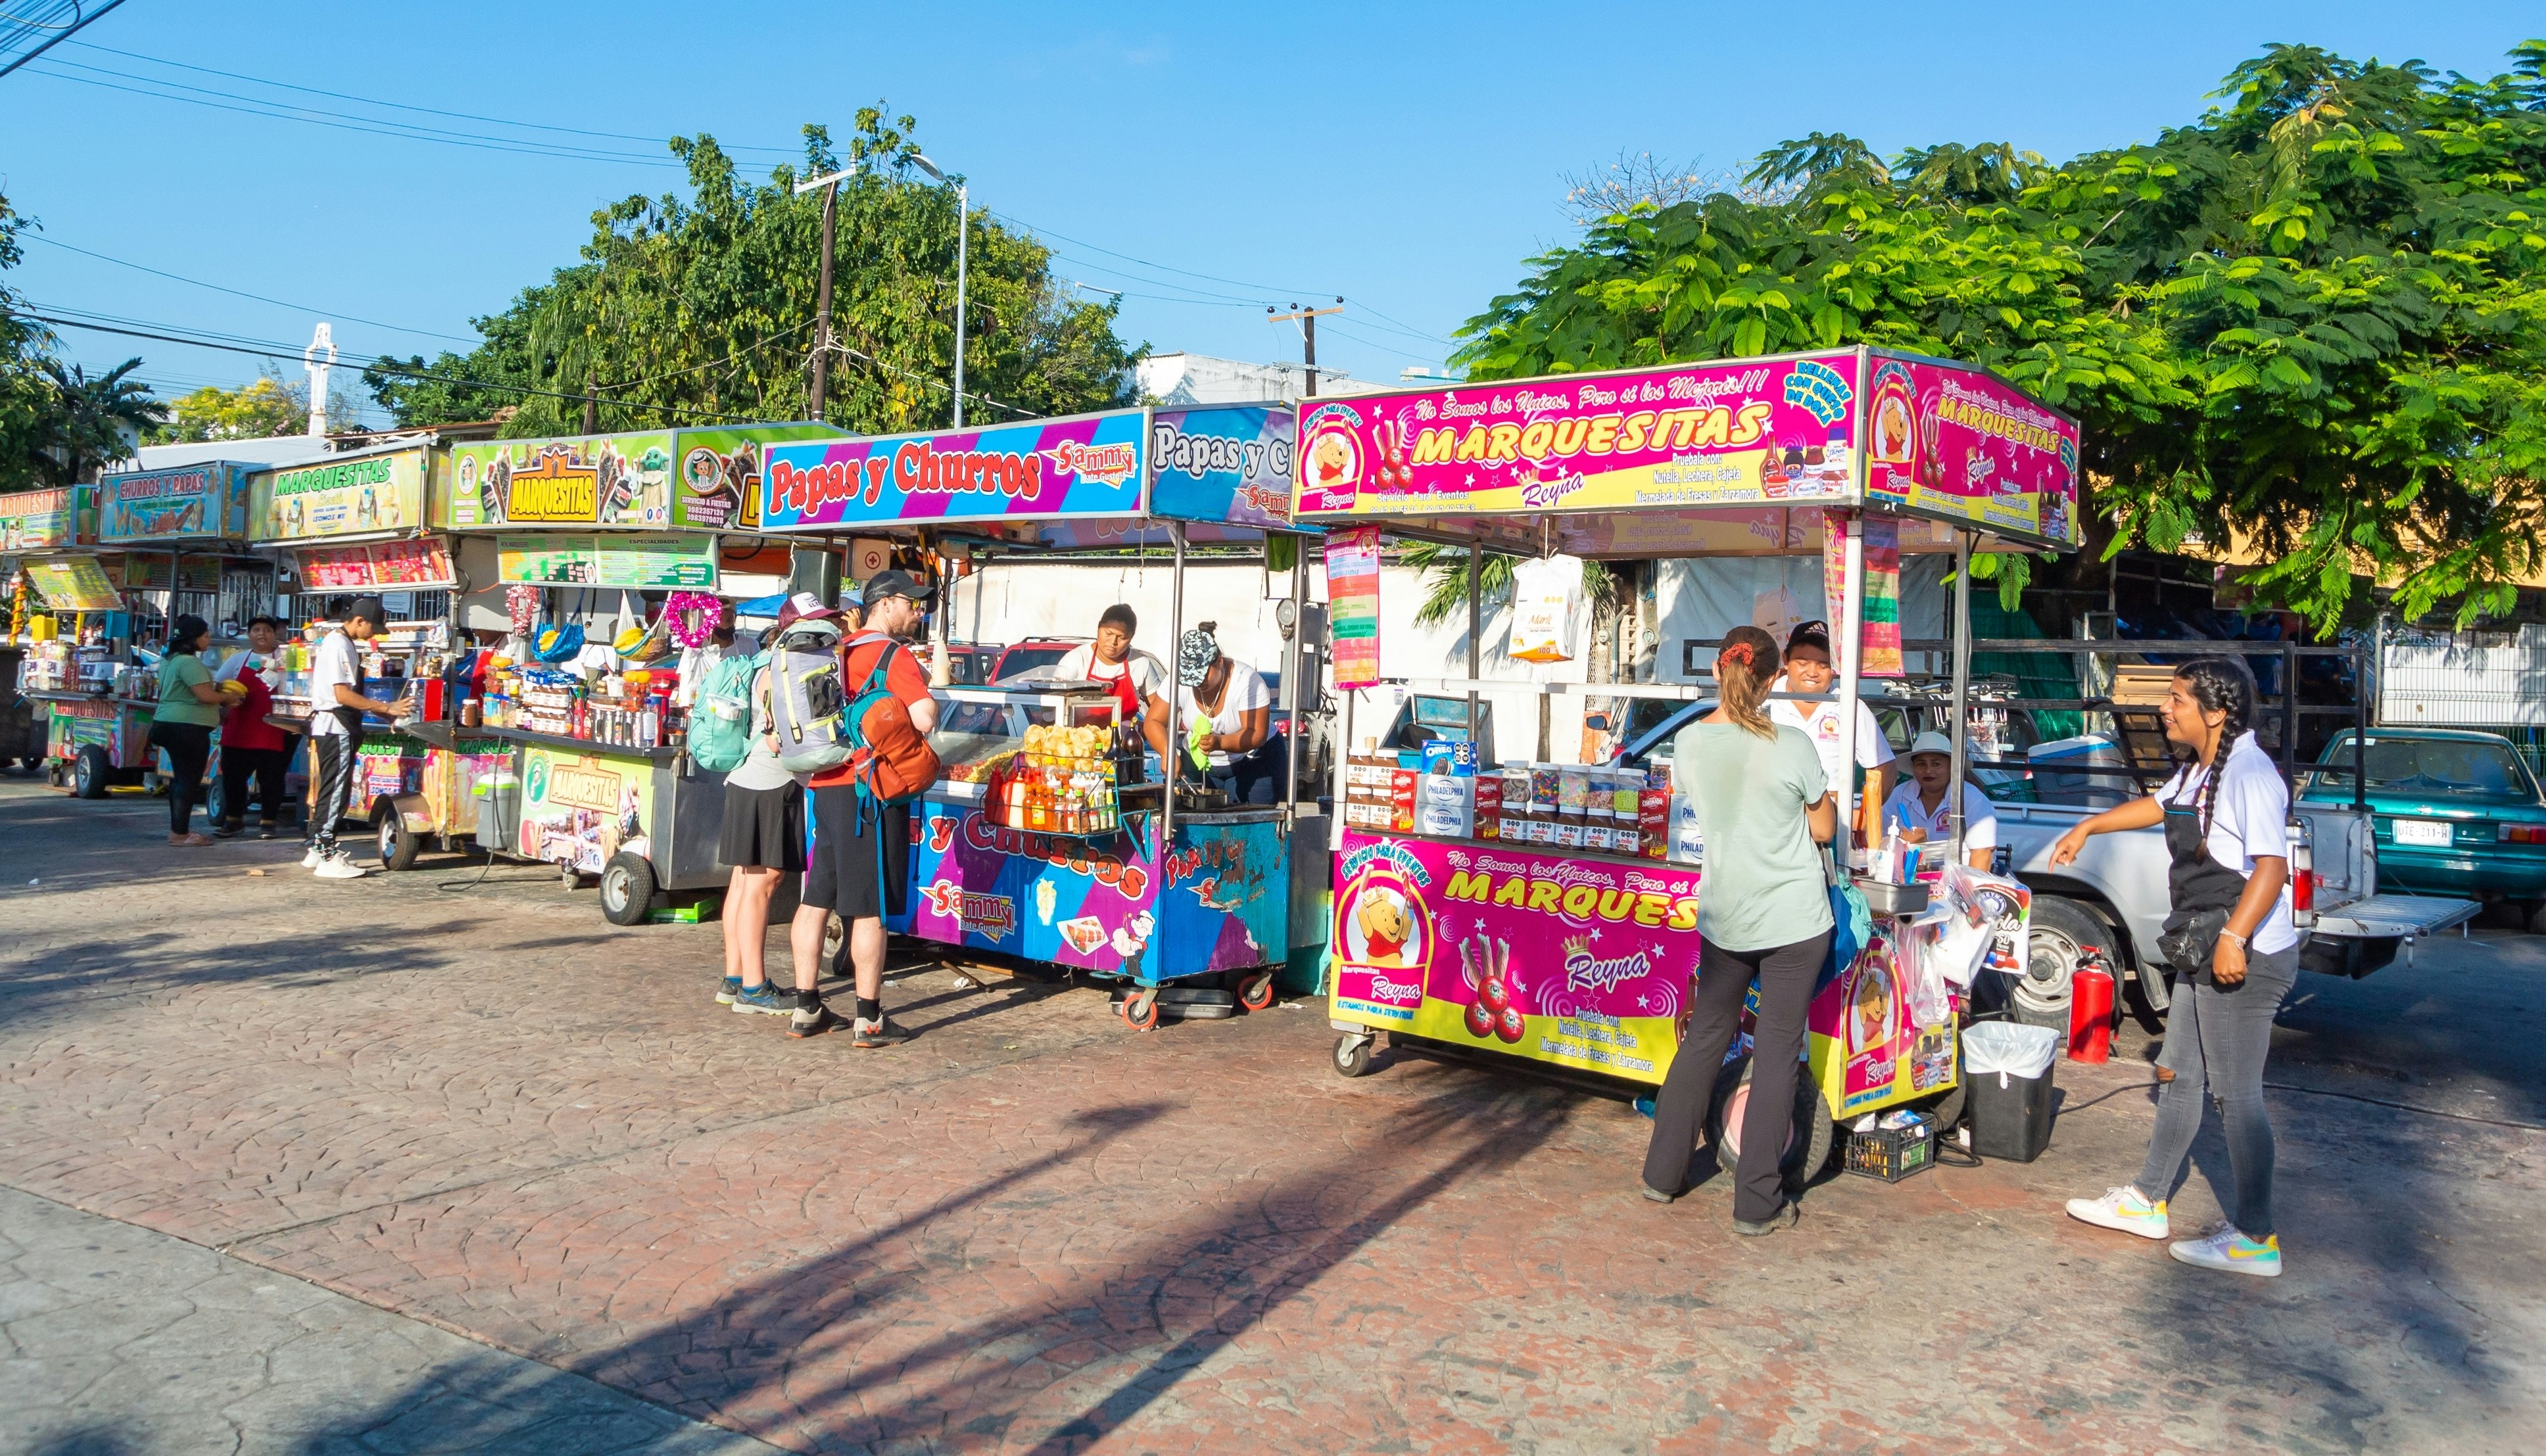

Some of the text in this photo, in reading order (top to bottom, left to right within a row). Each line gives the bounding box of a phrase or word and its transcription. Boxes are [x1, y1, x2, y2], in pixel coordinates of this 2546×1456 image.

[1416, 400, 1437, 421] No
[1440, 400, 1487, 419] Somos
[1491, 396, 1512, 415] los
[1515, 392, 1570, 419] Unicos,
[1579, 385, 1616, 409] Pero
[1641, 381, 1665, 401] los
[1668, 369, 1770, 403] Mejores!!!
[1797, 362, 1852, 401] RELLENAS
[1785, 375, 1844, 419] CON QUESO
[1786, 389, 1832, 425] DE BOLA
[1410, 402, 1772, 464] MARQUESITAS
[1938, 396, 2059, 453] MARQUESITAS
[1057, 442, 1134, 473] Sammy
[1154, 425, 1239, 476] Papas
[1245, 444, 1263, 479] y
[1671, 452, 1704, 467] Pruebala
[275, 458, 393, 496] MARQUESITAS
[770, 461, 859, 513] Papas
[865, 458, 888, 504] y
[894, 443, 1040, 498] Churros
[1082, 472, 1097, 482] Date
[1653, 466, 1741, 486] Nutella, Lechera, Cajeta
[1887, 469, 1910, 492] Reyna
[1967, 457, 1994, 483] Reyna
[120, 471, 204, 500] CHURROS Y PAPAS
[512, 477, 592, 519] MARQUESITAS
[1378, 490, 1469, 502] Servicio Para Eventos
[1522, 472, 1584, 507] Reyna
[1635, 489, 1675, 503] Mermelada
[1676, 489, 1685, 501] de
[1686, 488, 1711, 501] Fresas
[1719, 487, 1760, 500] Zarzamora
[0, 489, 68, 518] ARQUESITAS
[681, 496, 706, 505] SERVICIO
[711, 498, 731, 508] FIESTAS
[1322, 492, 1355, 509] Reyna
[1426, 745, 1452, 757] OREO
[552, 769, 617, 807] MARQUESITAS
[1428, 785, 1464, 796] PHILADELPHIA
[930, 818, 958, 851] y
[1426, 815, 1462, 826] PHILADELPHIA
[1681, 841, 1704, 853] PHILAD
[1342, 845, 1431, 885] SERVICIO PARA EVENTOS
[1448, 851, 1471, 866] No
[1476, 856, 1526, 875] Somos
[1531, 860, 1552, 876] los
[1554, 864, 1616, 885] Unicos,
[1626, 872, 1666, 891] Pero
[936, 885, 1013, 928] Sammy
[1445, 870, 1698, 931] MARQUES
[961, 920, 978, 931] Date
[1341, 966, 1380, 975] Marquesitas
[1566, 953, 1650, 991] Reyna
[1372, 977, 1420, 1004] Reyna
[1366, 1005, 1382, 1014] PARA
[1575, 1006, 1620, 1028] Pruebala con:
[1558, 1020, 1637, 1049] Nutella, Lechera, Cajeta
[1540, 1037, 1654, 1073] Mermelada de Fresas y Zarzamora
[1865, 1057, 1895, 1085] Reyna
